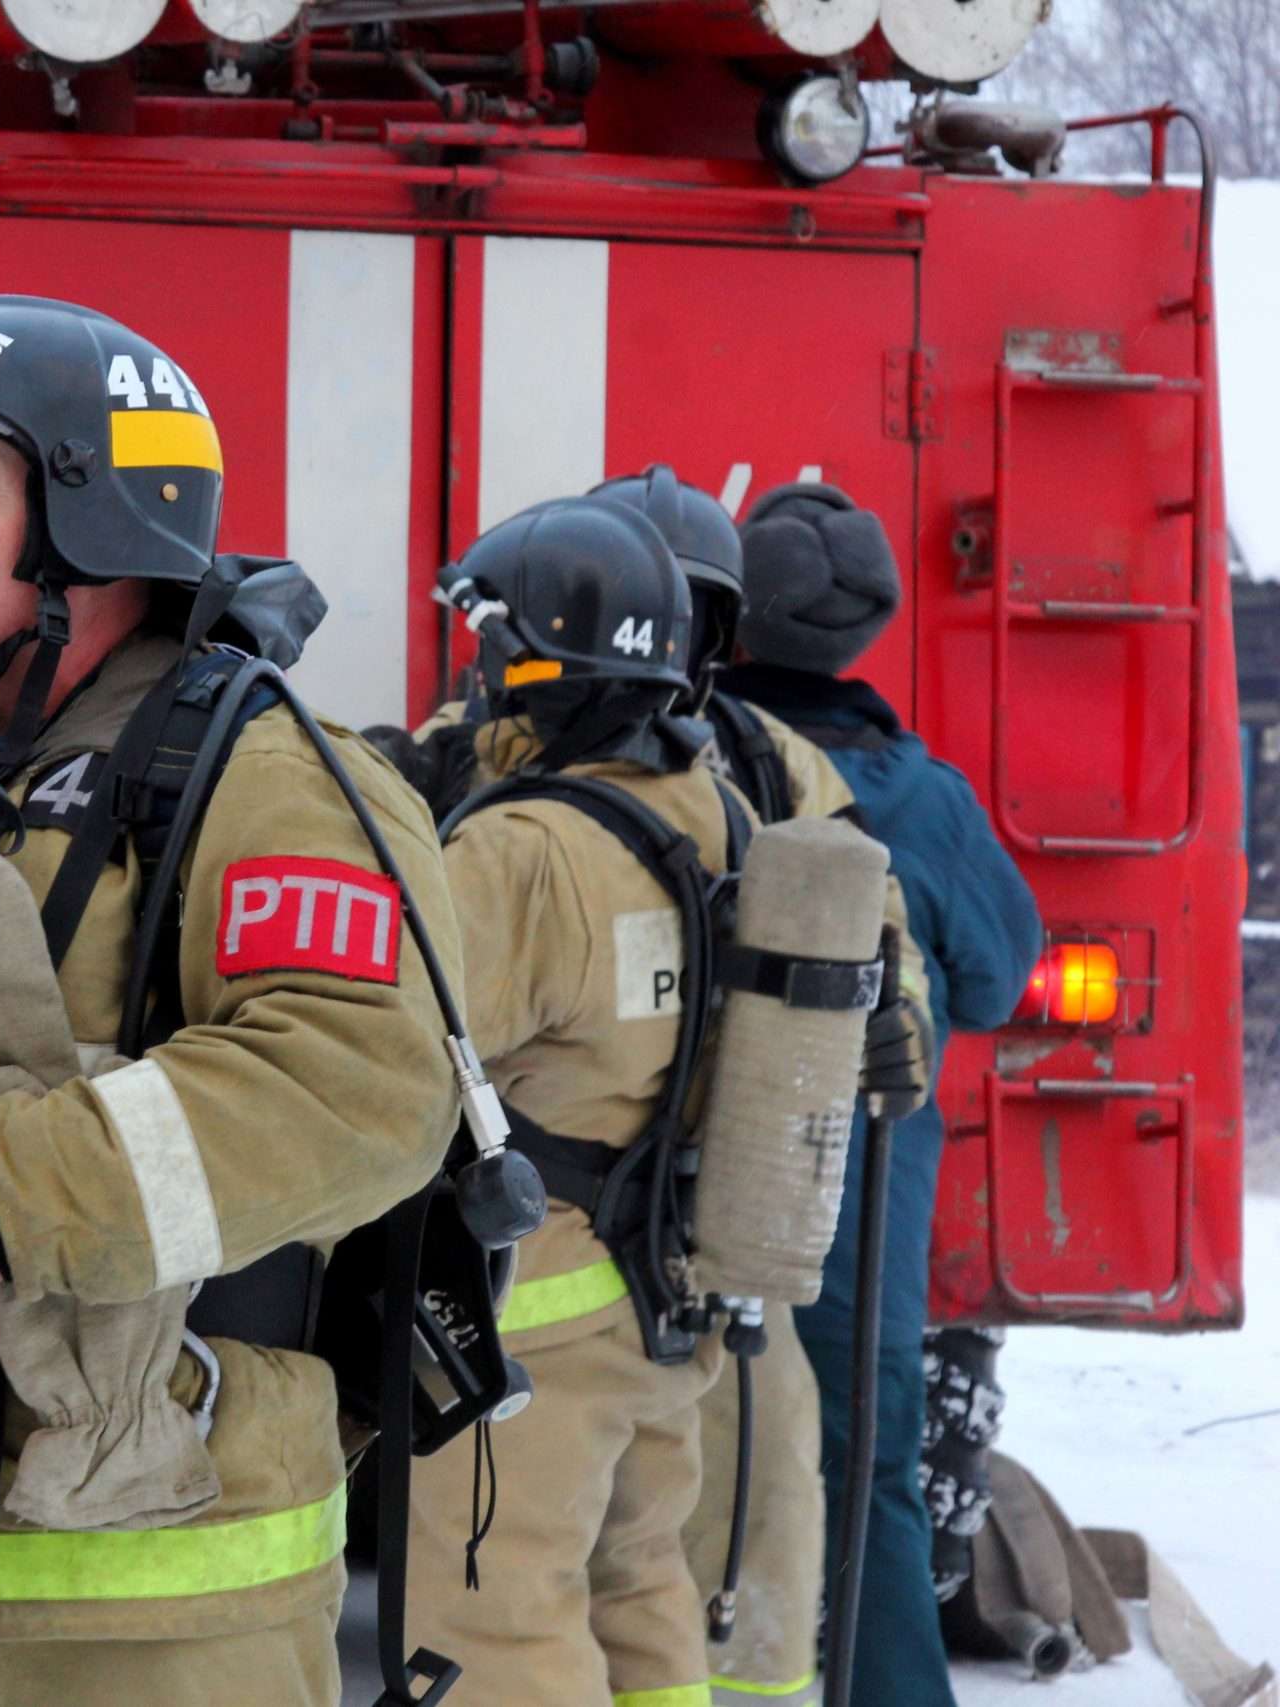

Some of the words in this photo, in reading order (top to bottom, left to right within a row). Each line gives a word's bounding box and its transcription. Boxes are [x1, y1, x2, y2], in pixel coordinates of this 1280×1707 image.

[612, 616, 654, 657] 44
[28, 752, 94, 814] 4
[225, 875, 391, 966] РТП
